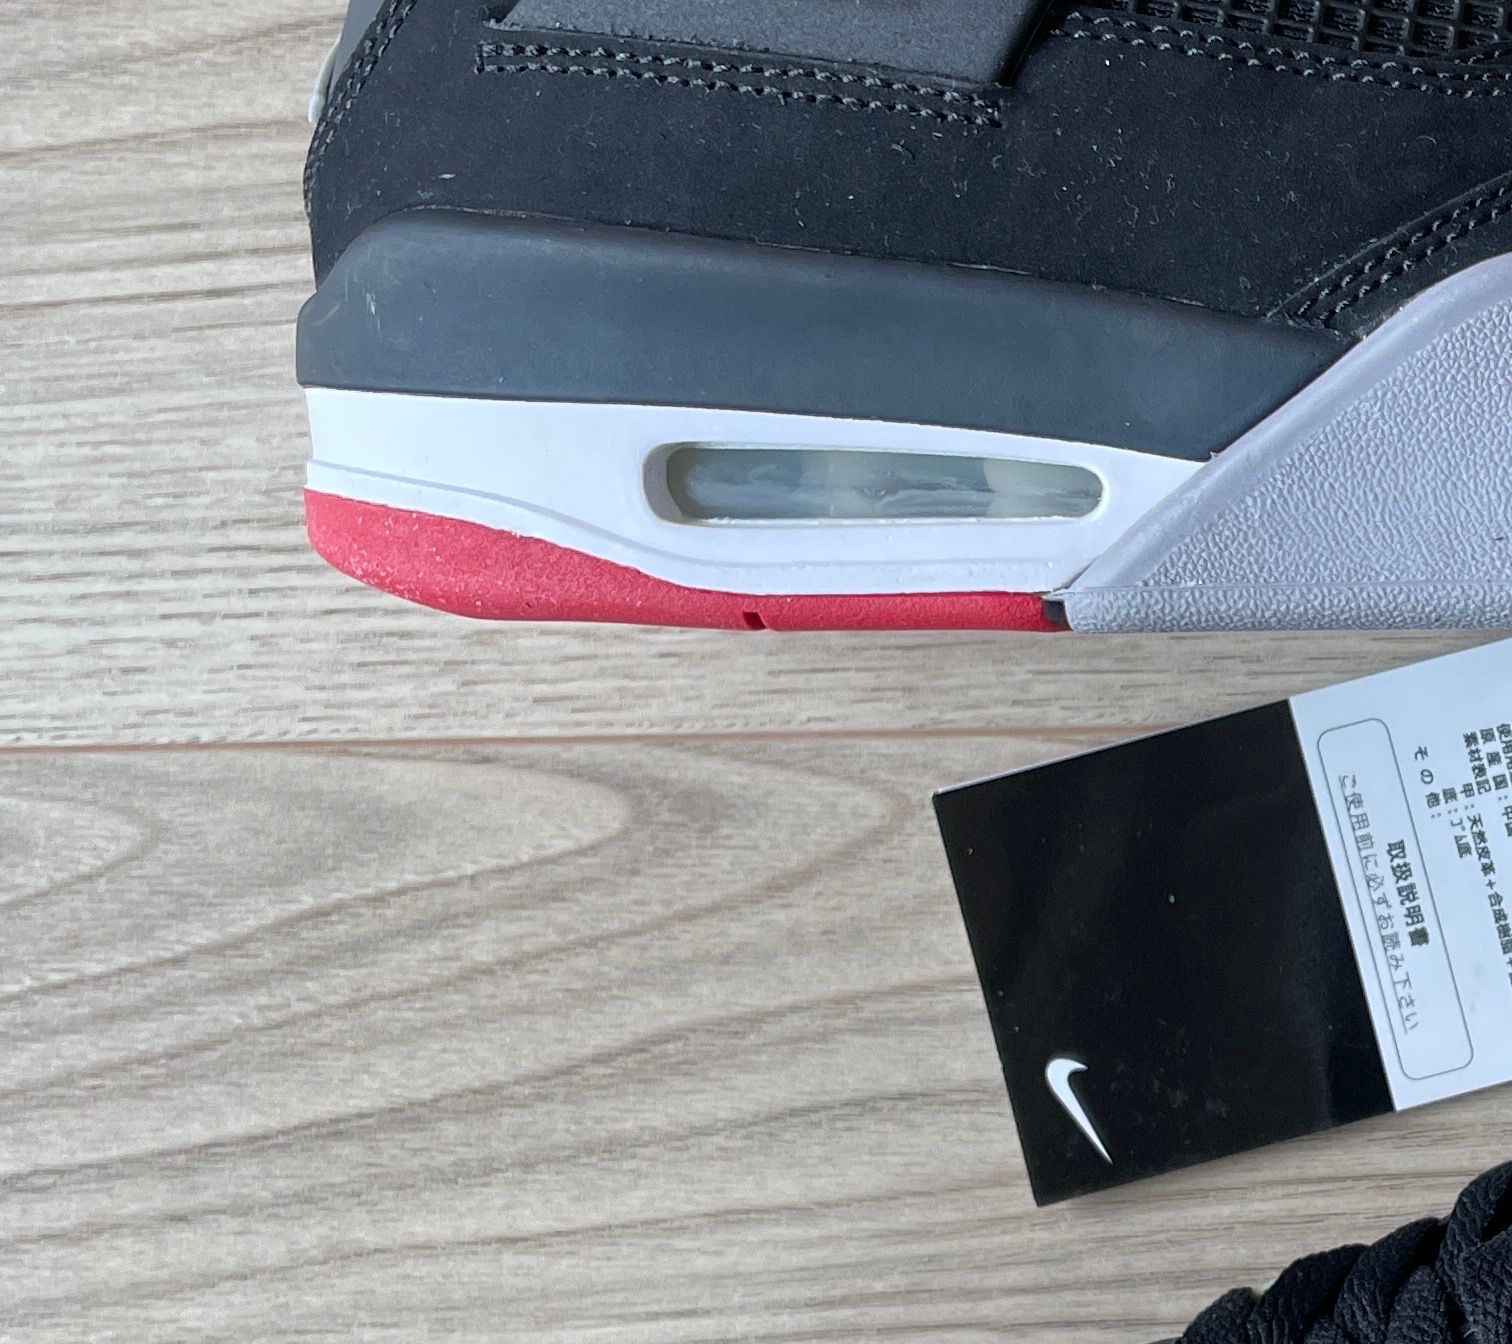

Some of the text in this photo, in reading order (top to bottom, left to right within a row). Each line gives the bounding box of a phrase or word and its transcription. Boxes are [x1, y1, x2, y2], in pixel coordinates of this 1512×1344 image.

[1462, 731, 1492, 796] 素材表記
[1338, 775, 1418, 1031] ご使用前に必ずお読み下さい
[1386, 839, 1430, 947] 取扱説明書
